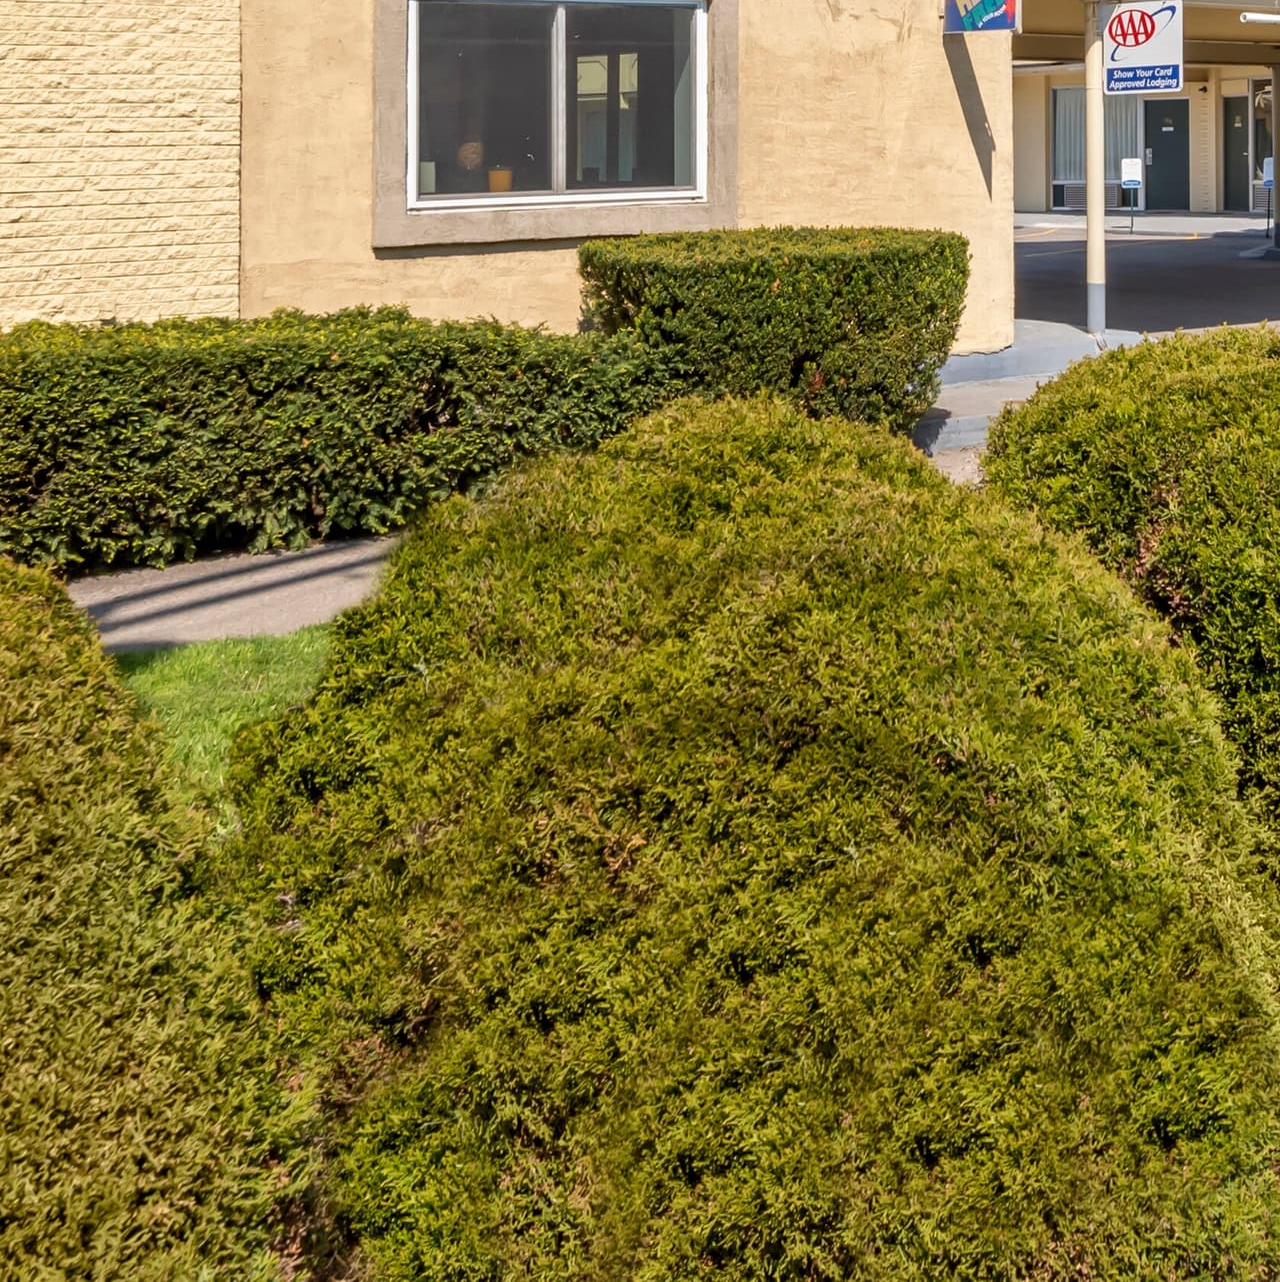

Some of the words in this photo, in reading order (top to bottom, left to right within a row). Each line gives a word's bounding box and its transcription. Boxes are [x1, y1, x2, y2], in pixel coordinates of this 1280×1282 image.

[1112, 10, 1151, 46] AAA
[1113, 70, 1135, 79] Show
[1136, 68, 1153, 78] Your
[1154, 66, 1173, 77] Card
[1109, 79, 1146, 91] Approved
[1146, 77, 1178, 88] Lodging
